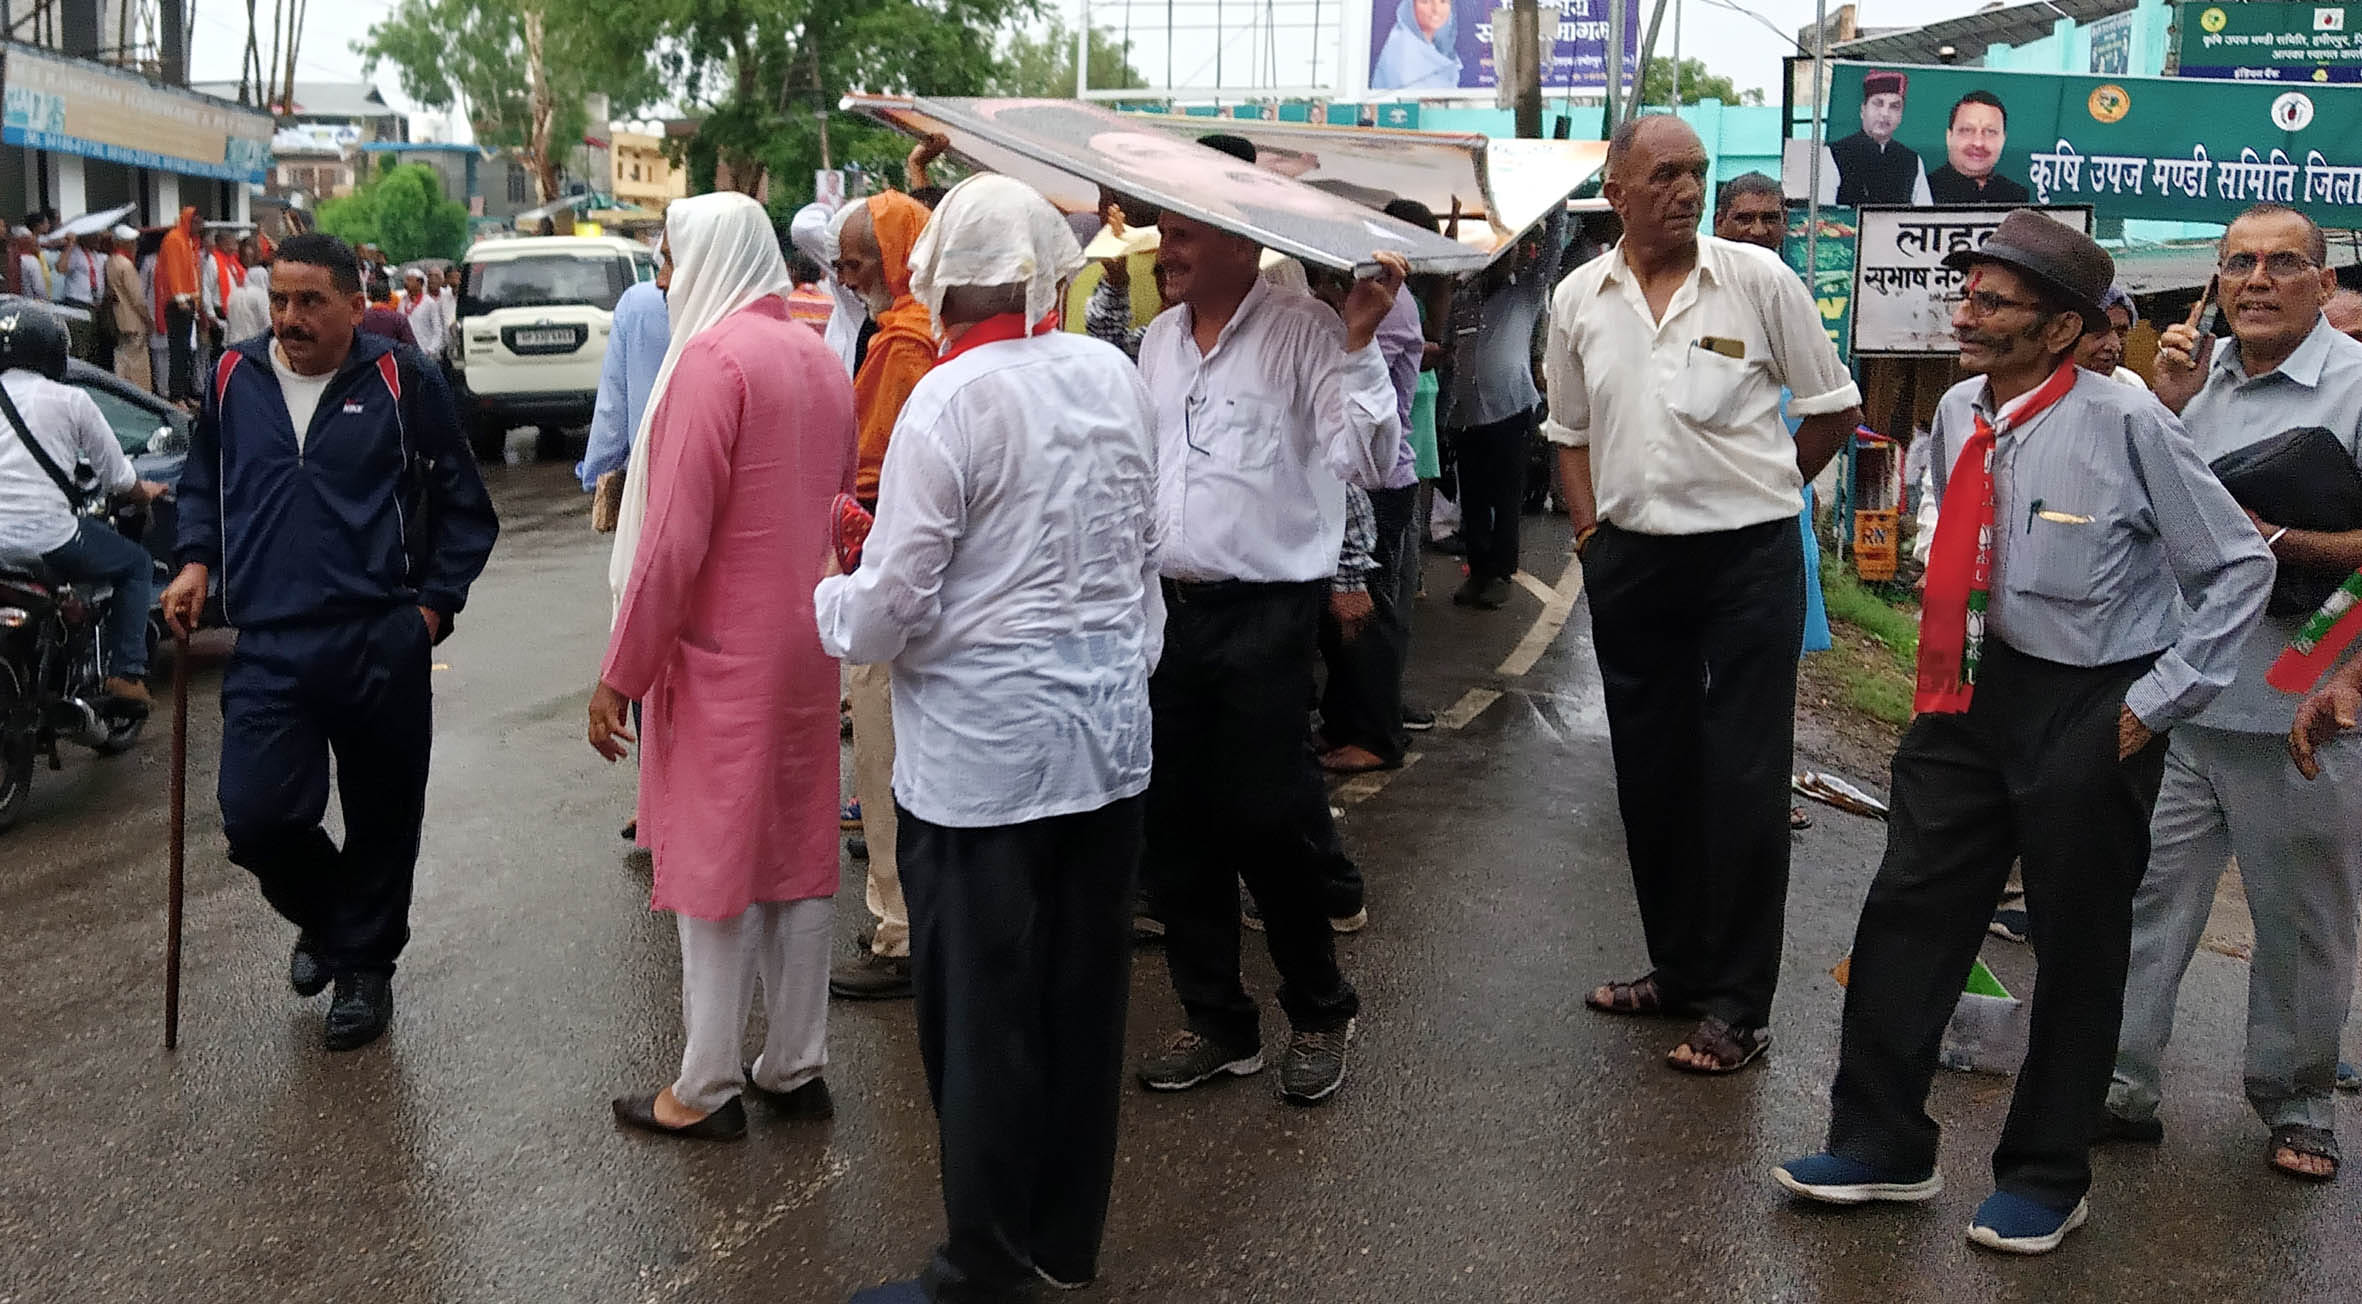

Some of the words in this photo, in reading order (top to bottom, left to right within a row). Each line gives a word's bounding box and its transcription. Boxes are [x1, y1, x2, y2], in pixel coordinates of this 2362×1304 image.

[2028, 138, 2085, 205] कृषि
[2089, 155, 2148, 195] उपज
[2152, 143, 2212, 198] मण्डी
[2216, 146, 2299, 202] समिति
[1864, 266, 1931, 296] सुभाष
